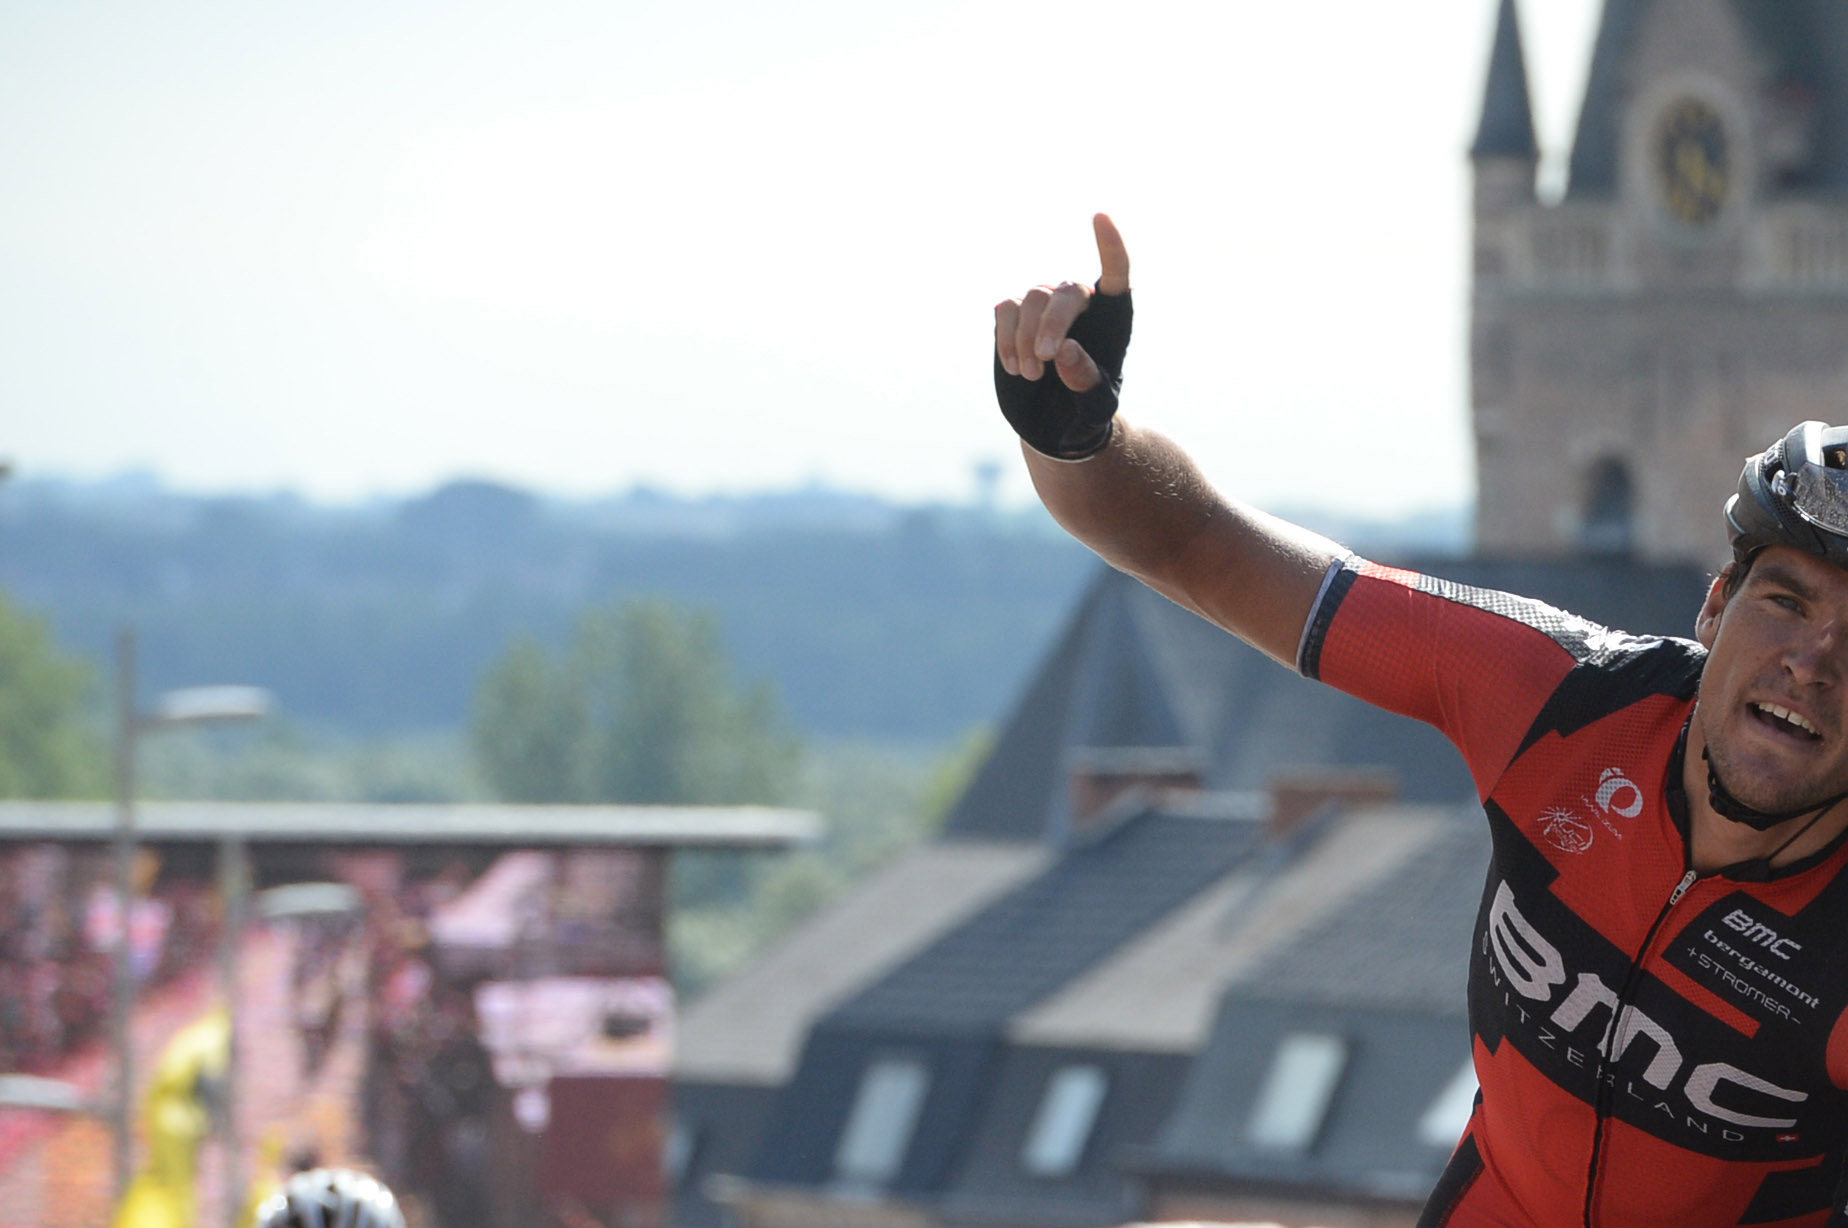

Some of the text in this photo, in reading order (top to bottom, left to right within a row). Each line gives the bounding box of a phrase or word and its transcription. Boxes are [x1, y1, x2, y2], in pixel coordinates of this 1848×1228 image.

[1489, 879, 1808, 1127] BMC
[1703, 930, 1820, 1009] bergamont
[1722, 909, 1802, 960] BMC
[1483, 930, 1745, 1142] SWITZERLAND
